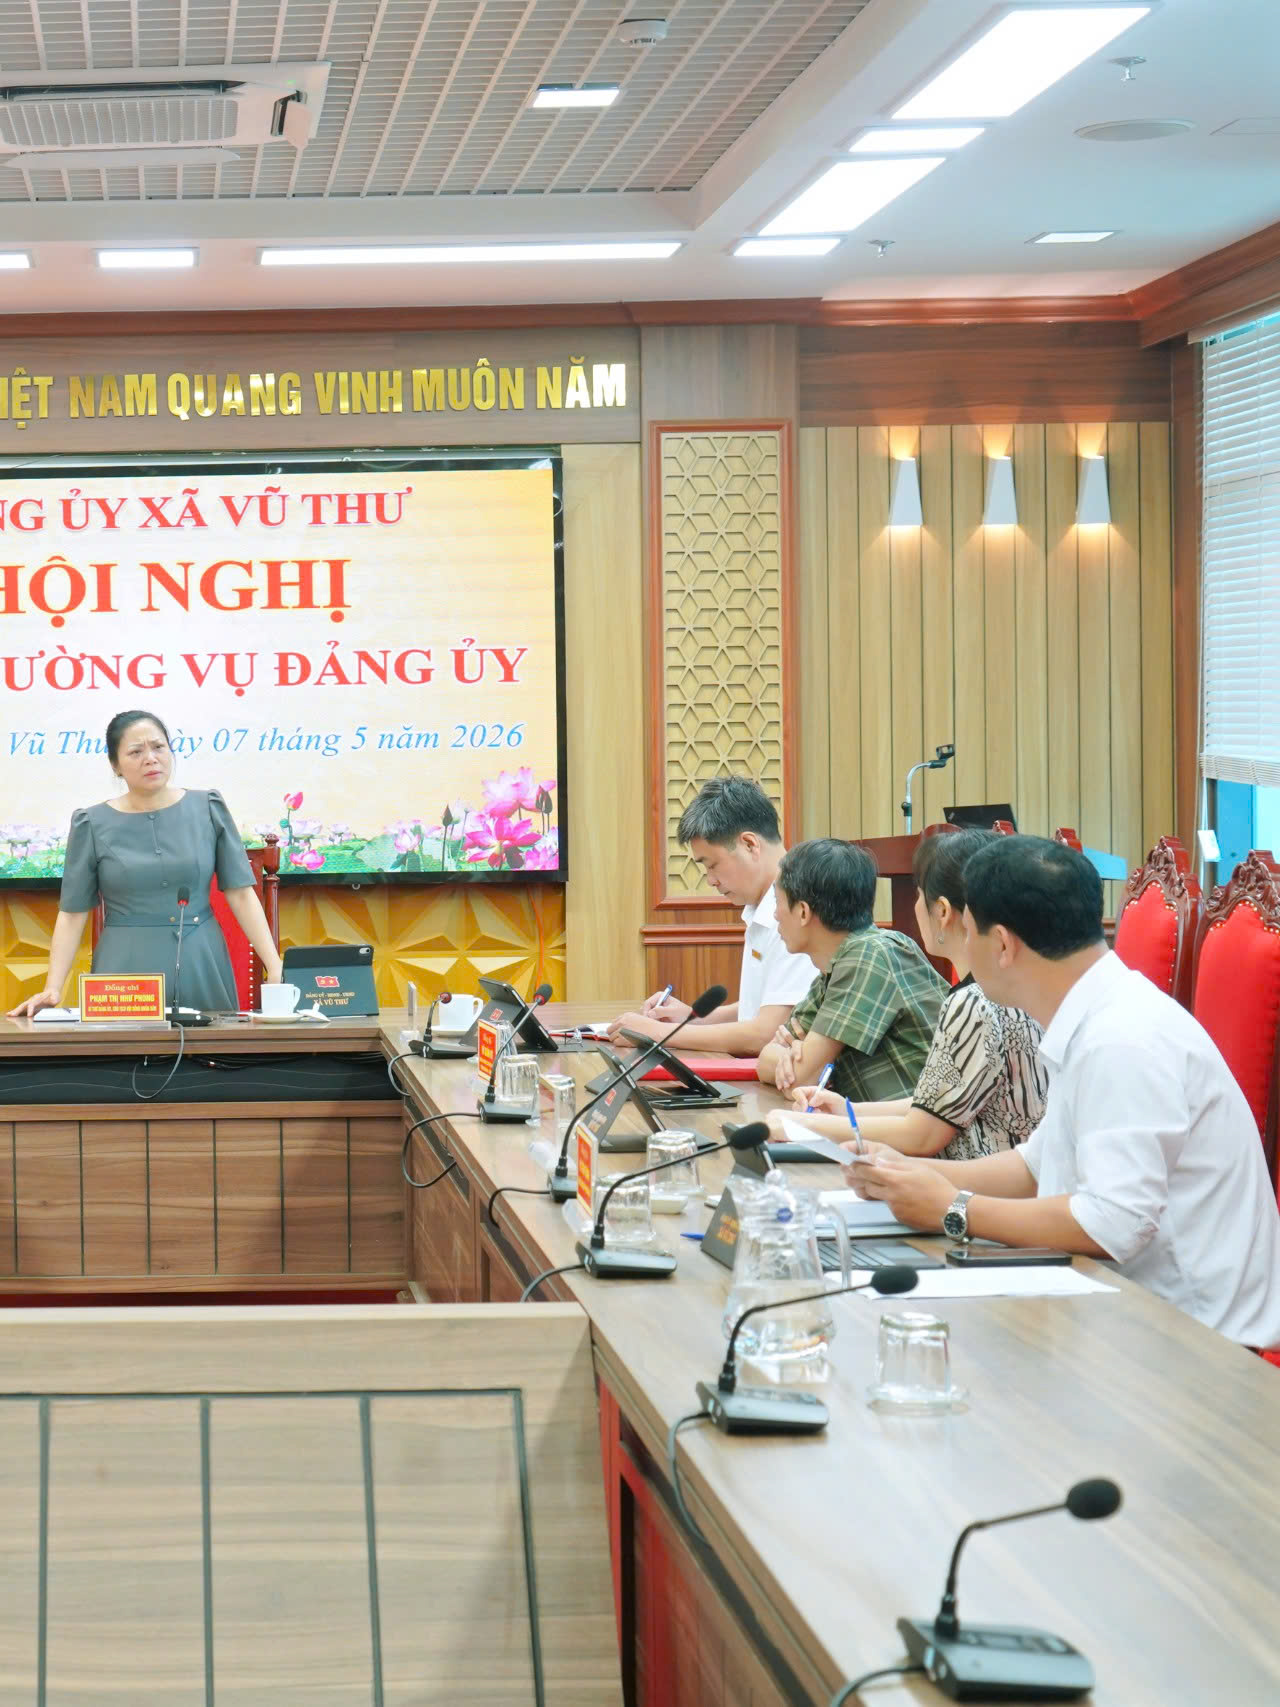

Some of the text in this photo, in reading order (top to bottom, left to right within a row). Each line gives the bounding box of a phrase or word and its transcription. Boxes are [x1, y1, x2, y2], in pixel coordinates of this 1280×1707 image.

[69, 373, 156, 418] NAM
[167, 372, 302, 420] QUANG
[314, 370, 402, 414] VINH
[412, 358, 524, 412] MUÔN
[537, 356, 626, 408] NĂM
[59, 488, 128, 530] ỦY
[138, 488, 208, 528] XÃ
[219, 486, 290, 527] VŨ
[301, 486, 413, 525] THƯ
[139, 558, 352, 623] NGHỊ
[181, 652, 259, 697] VỤ
[274, 640, 435, 687] ĐẢNG
[450, 638, 529, 684] ỦY
[9, 731, 53, 755] Vũ
[213, 728, 248, 752] 07
[258, 727, 341, 756] tháng
[351, 726, 368, 750] 5
[378, 726, 440, 749] năm
[451, 723, 524, 748] 2026
